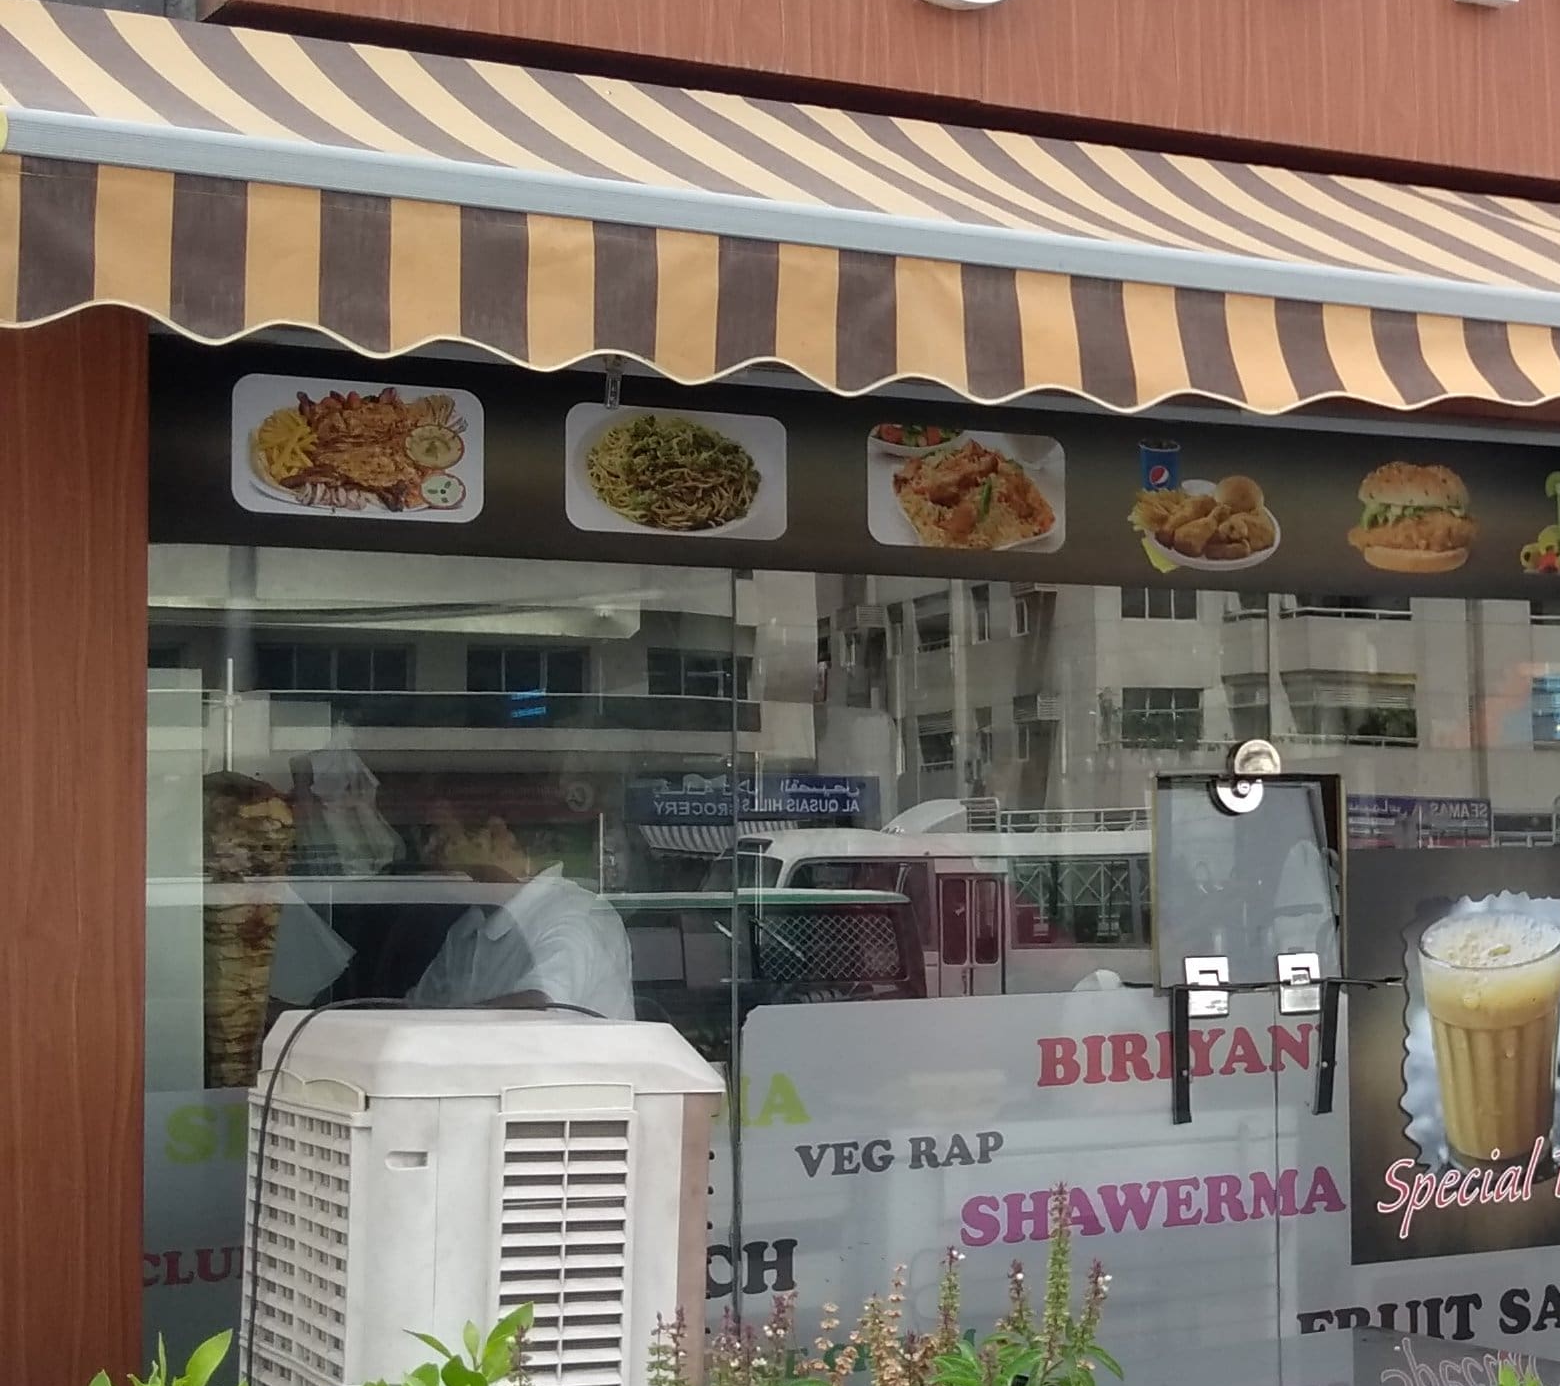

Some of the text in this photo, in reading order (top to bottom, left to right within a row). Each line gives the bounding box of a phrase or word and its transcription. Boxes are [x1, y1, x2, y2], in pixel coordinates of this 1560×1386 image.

[1037, 1023, 1322, 1087] BIRIYAN
[795, 1131, 1004, 1178] VEG RAP
[960, 1166, 1347, 1248] SHAWERMA
[1376, 1135, 1546, 1239] Special
[144, 1244, 245, 1288] CLU
